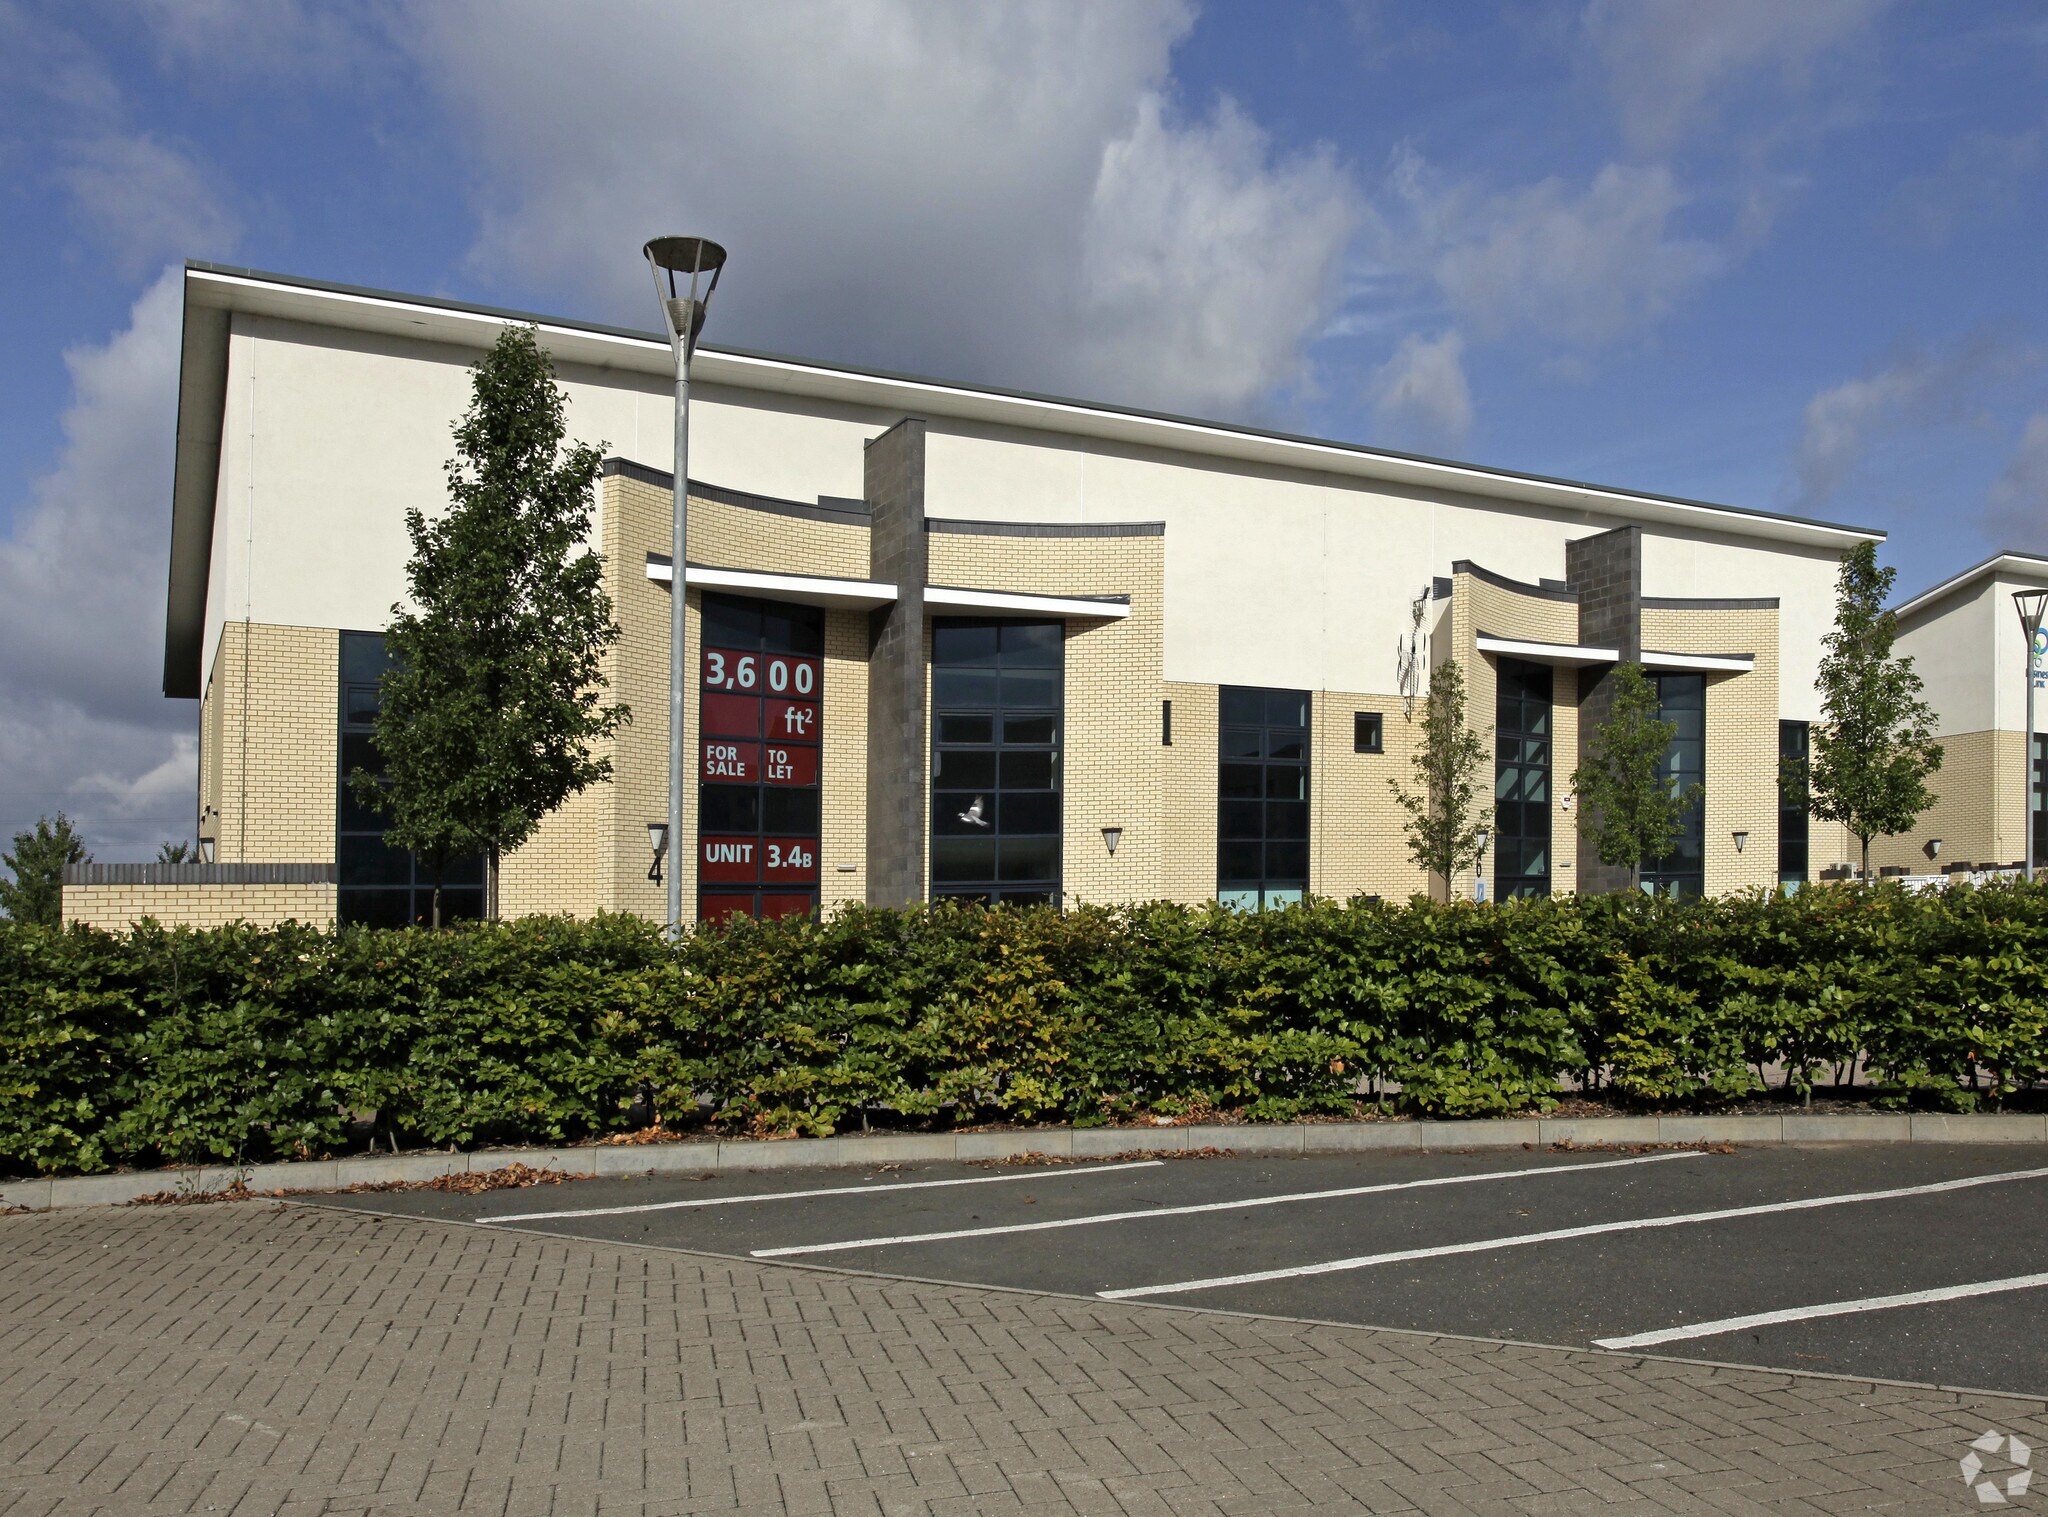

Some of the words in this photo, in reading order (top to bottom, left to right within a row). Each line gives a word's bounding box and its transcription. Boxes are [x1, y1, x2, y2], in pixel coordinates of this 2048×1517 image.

[706, 652, 813, 694] 3,600
[706, 745, 737, 761] FOR
[768, 750, 787, 764] TO
[706, 761, 745, 777] SALE
[768, 765, 793, 779] LET
[705, 844, 753, 863] UNIT
[767, 845, 812, 868] 3.4B
[648, 856, 663, 887] 4
